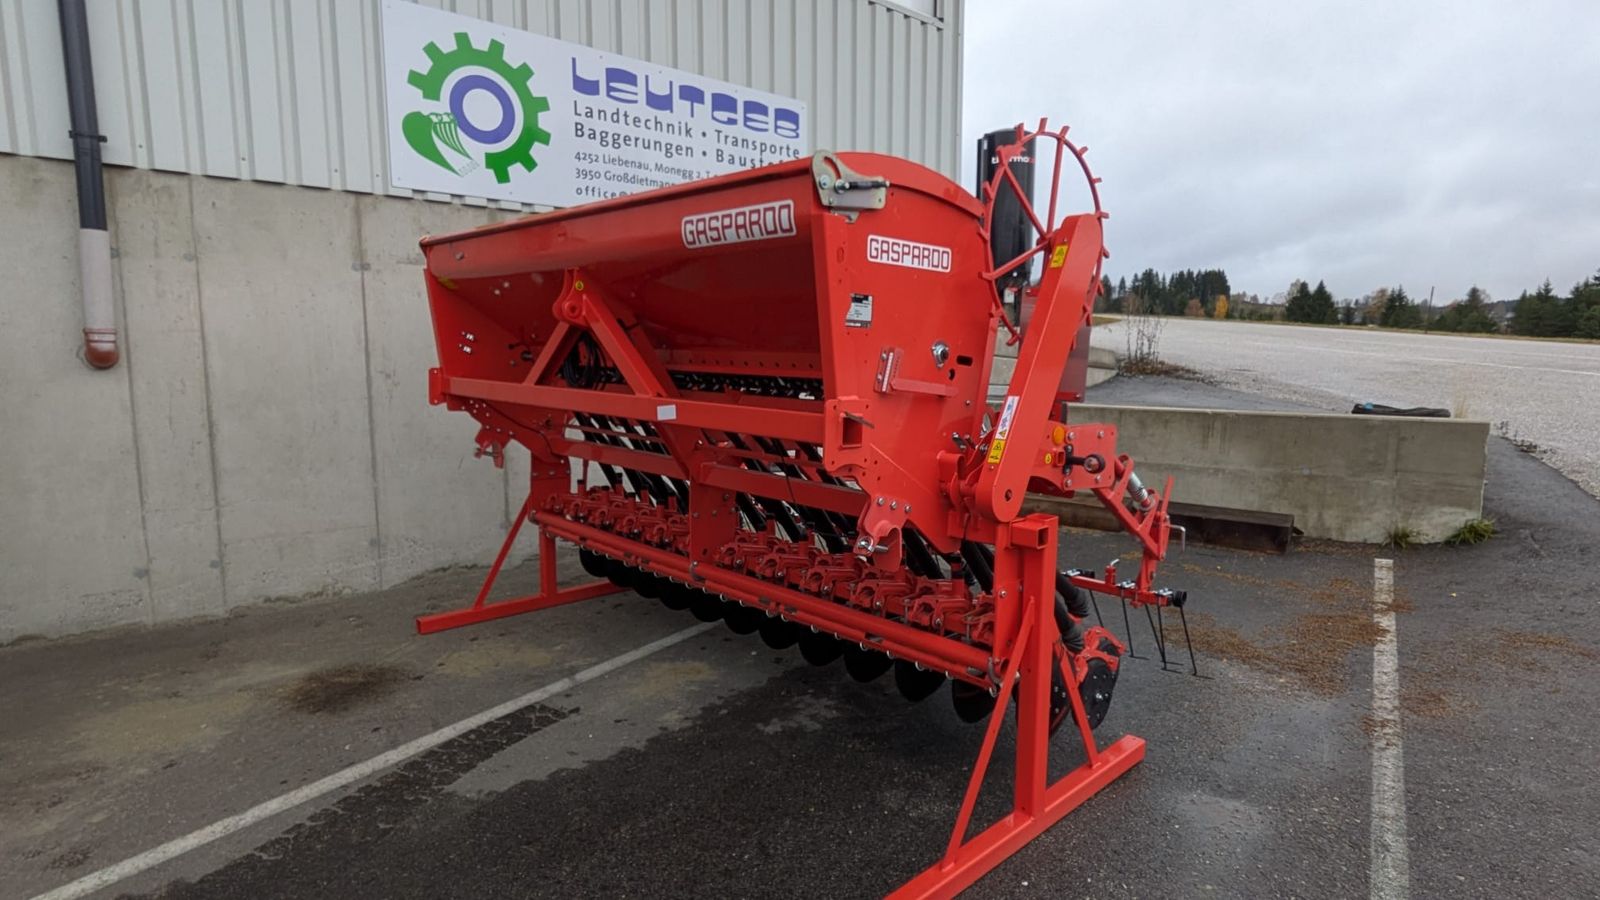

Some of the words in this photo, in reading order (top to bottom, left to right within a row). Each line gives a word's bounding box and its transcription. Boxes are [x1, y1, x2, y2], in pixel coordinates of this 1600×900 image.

[572, 57, 800, 139] LEUTGEB
[573, 100, 694, 138] Landtechnik
[715, 129, 800, 160] Transporte
[575, 122, 694, 159] Baggerungen
[574, 151, 600, 164] 4252
[602, 153, 653, 172] Liebenau,
[655, 163, 694, 181] Monegg
[575, 168, 602, 181] 3950
[683, 203, 794, 246] GASPARDO
[869, 237, 950, 270] GASPARDO
